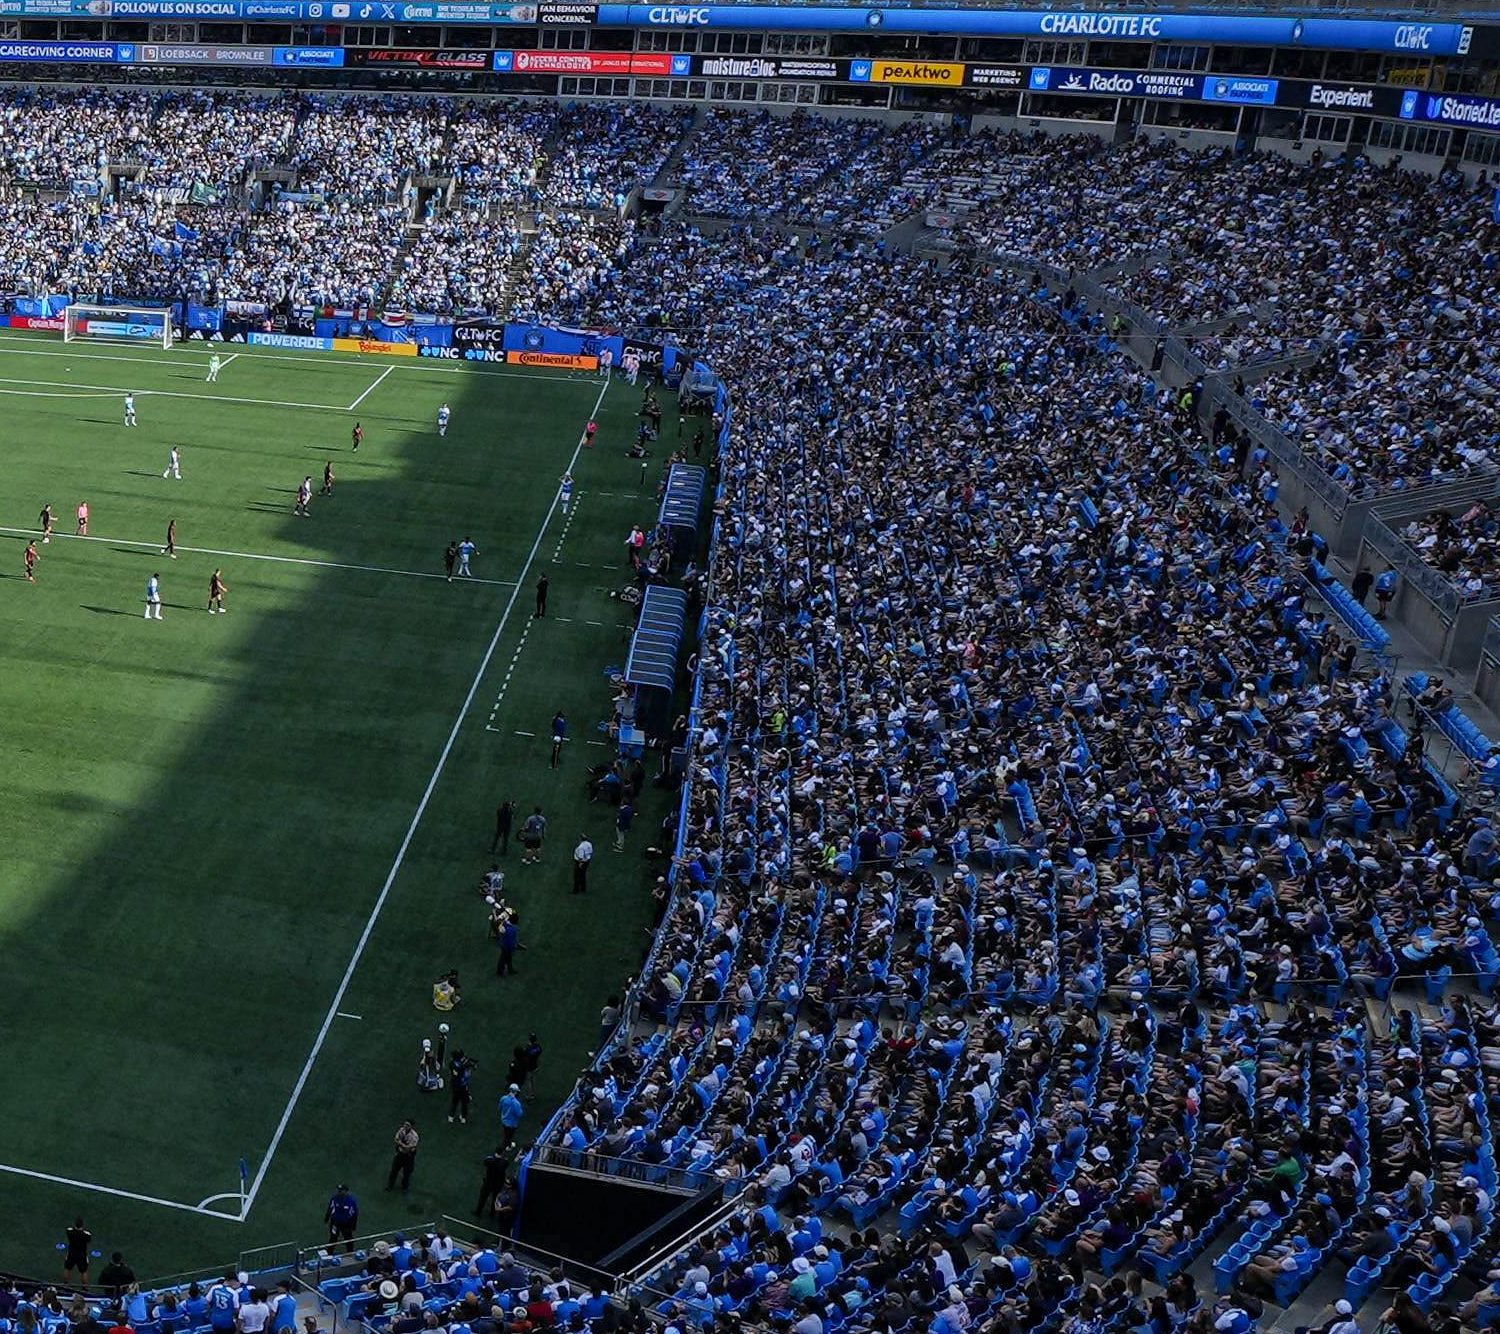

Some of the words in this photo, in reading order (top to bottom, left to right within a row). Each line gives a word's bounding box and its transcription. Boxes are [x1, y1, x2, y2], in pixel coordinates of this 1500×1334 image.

[113, 2, 158, 14] FOLLOW
[176, 2, 194, 15] ON
[196, 3, 236, 15] SOCIAL
[539, 5, 556, 14] FAN
[556, 5, 596, 15] BEHAVIOR
[1040, 15, 1139, 35] CHARLOTTE
[1142, 18, 1162, 36] FC
[0, 46, 66, 58] CAREGIVING
[67, 46, 113, 58] CORNER
[160, 49, 209, 59] LOEBSACK
[215, 50, 265, 60] BROWNLEE
[366, 50, 432, 62] VICTORY
[436, 52, 488, 63] GLASS
[973, 68, 1016, 77] MARKETING
[989, 76, 1020, 85] AGENCY
[1088, 72, 1134, 93] Radco
[1137, 73, 1195, 87] COMMERCIAL
[1145, 84, 1184, 96] ROOFING
[1309, 85, 1374, 108] Experient
[252, 335, 325, 349] POWERADE
[518, 352, 574, 366] Continental
